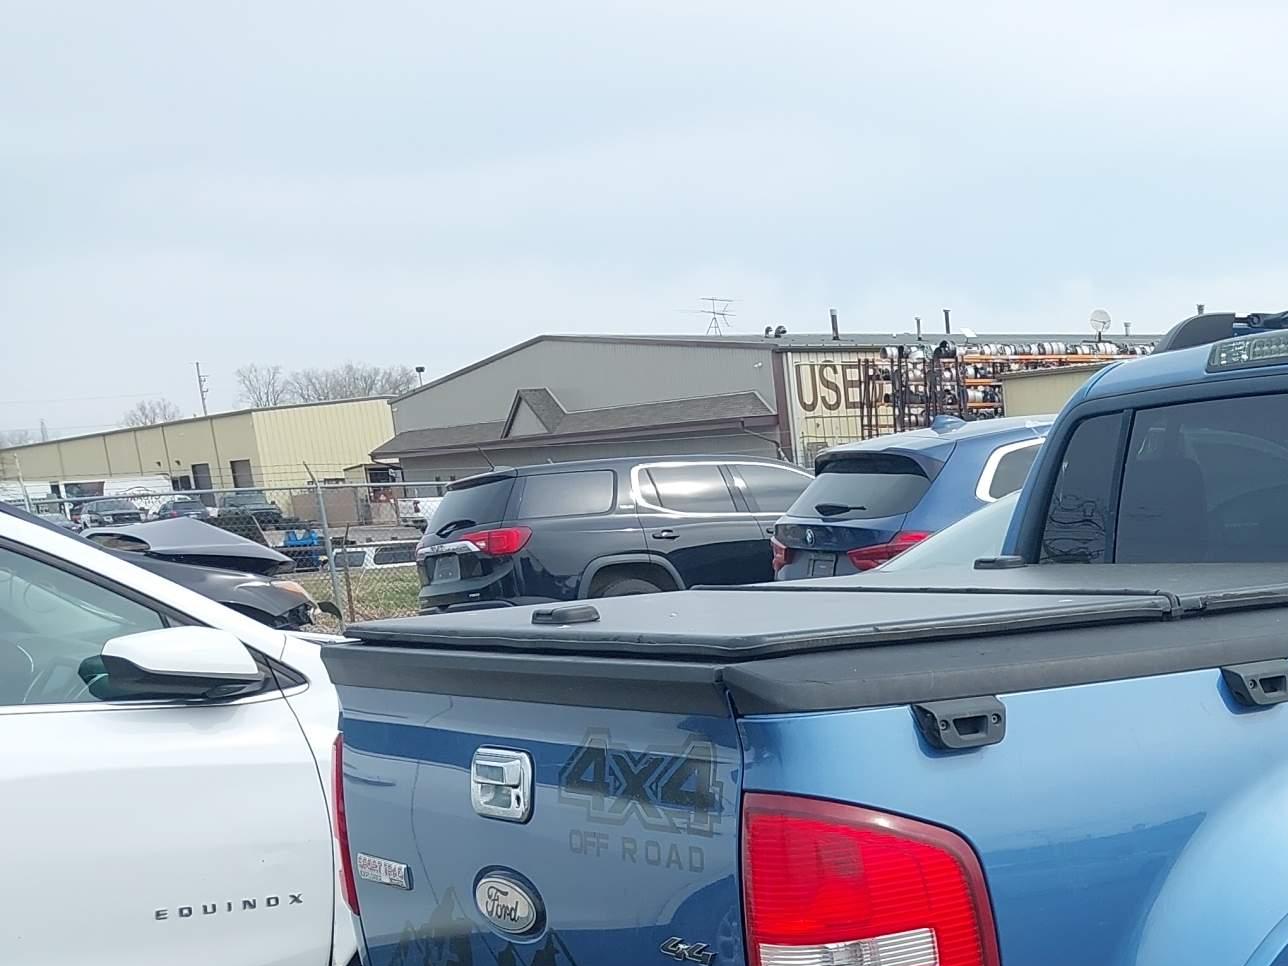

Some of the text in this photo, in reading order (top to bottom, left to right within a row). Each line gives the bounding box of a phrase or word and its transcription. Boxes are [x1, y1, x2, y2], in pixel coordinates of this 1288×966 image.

[569, 829, 705, 873] OFF ROAD
[155, 893, 303, 921] EQUINOX
[485, 885, 520, 922] Ford
